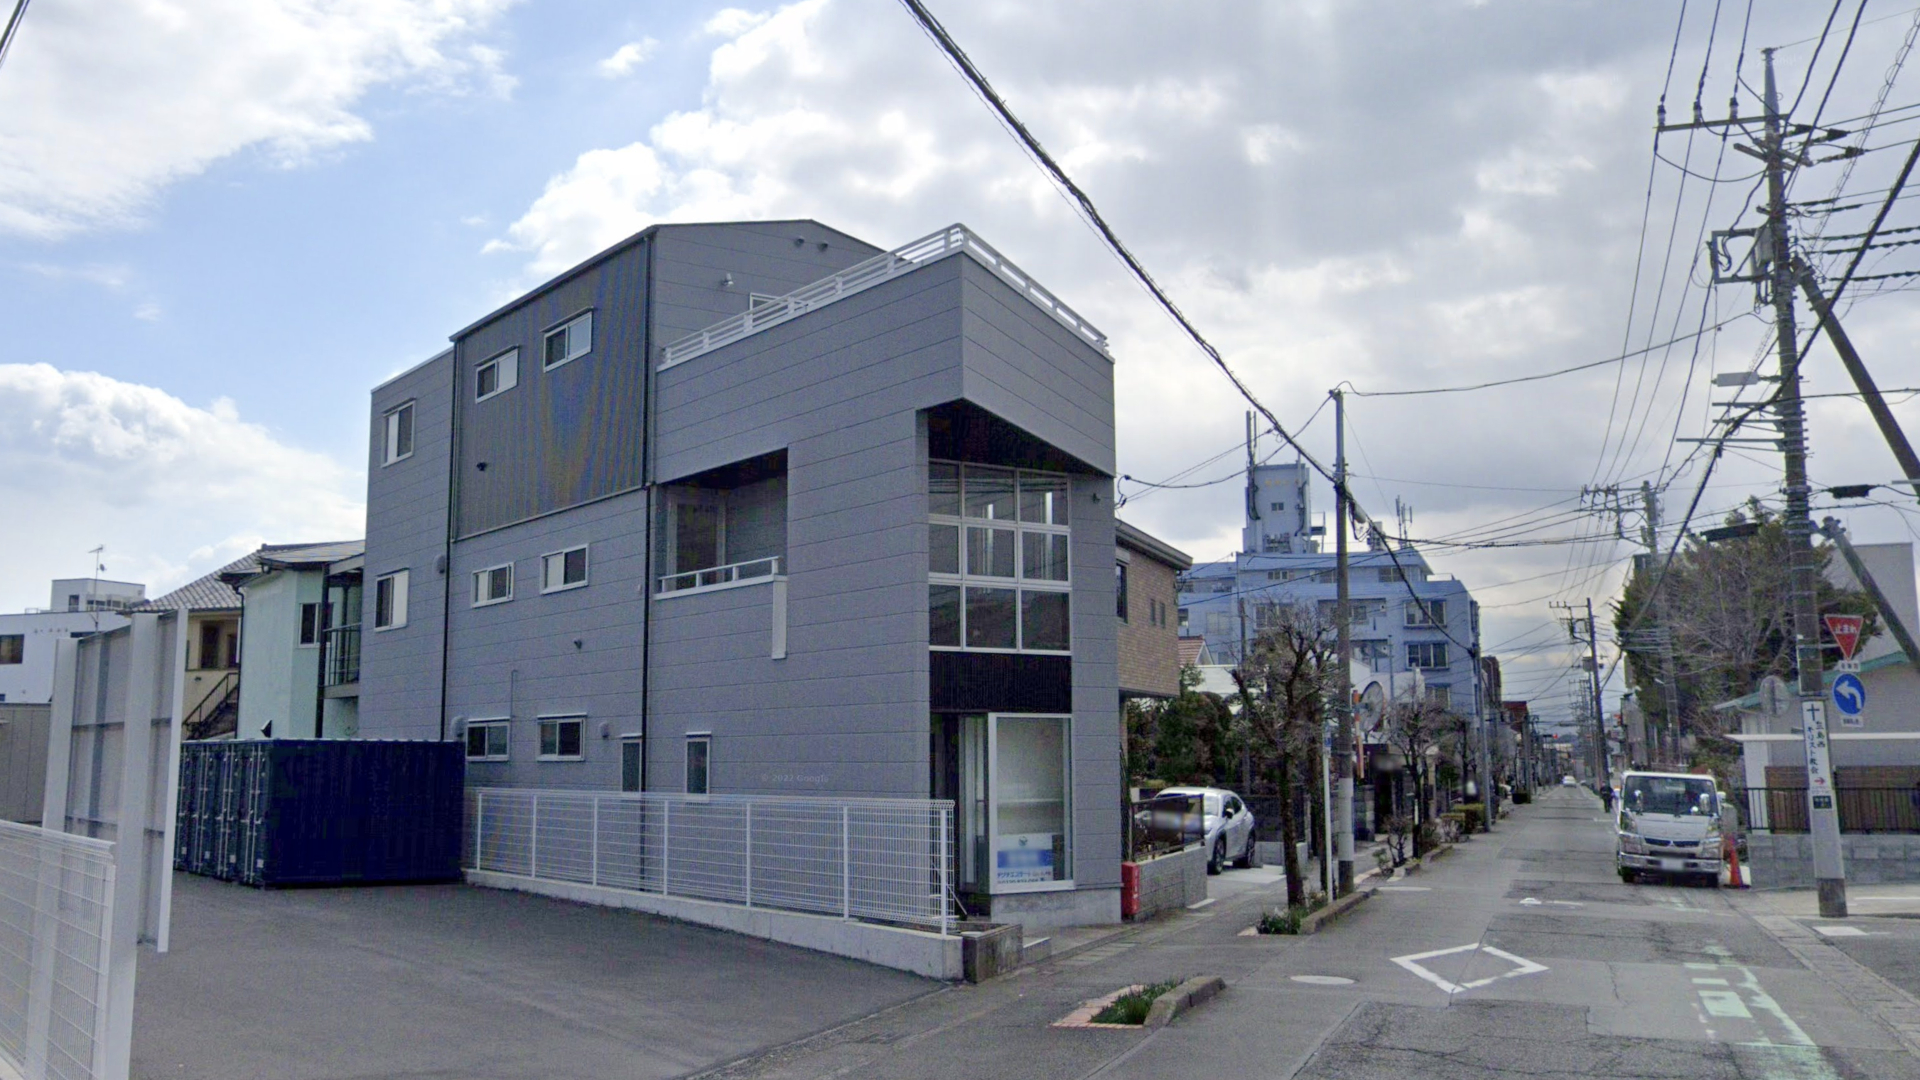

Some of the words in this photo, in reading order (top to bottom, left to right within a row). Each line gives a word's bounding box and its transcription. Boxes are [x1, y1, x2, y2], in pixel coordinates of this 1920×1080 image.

[1835, 623, 1857, 634] 止まれ
[1807, 726, 1819, 774] キリスト教会
